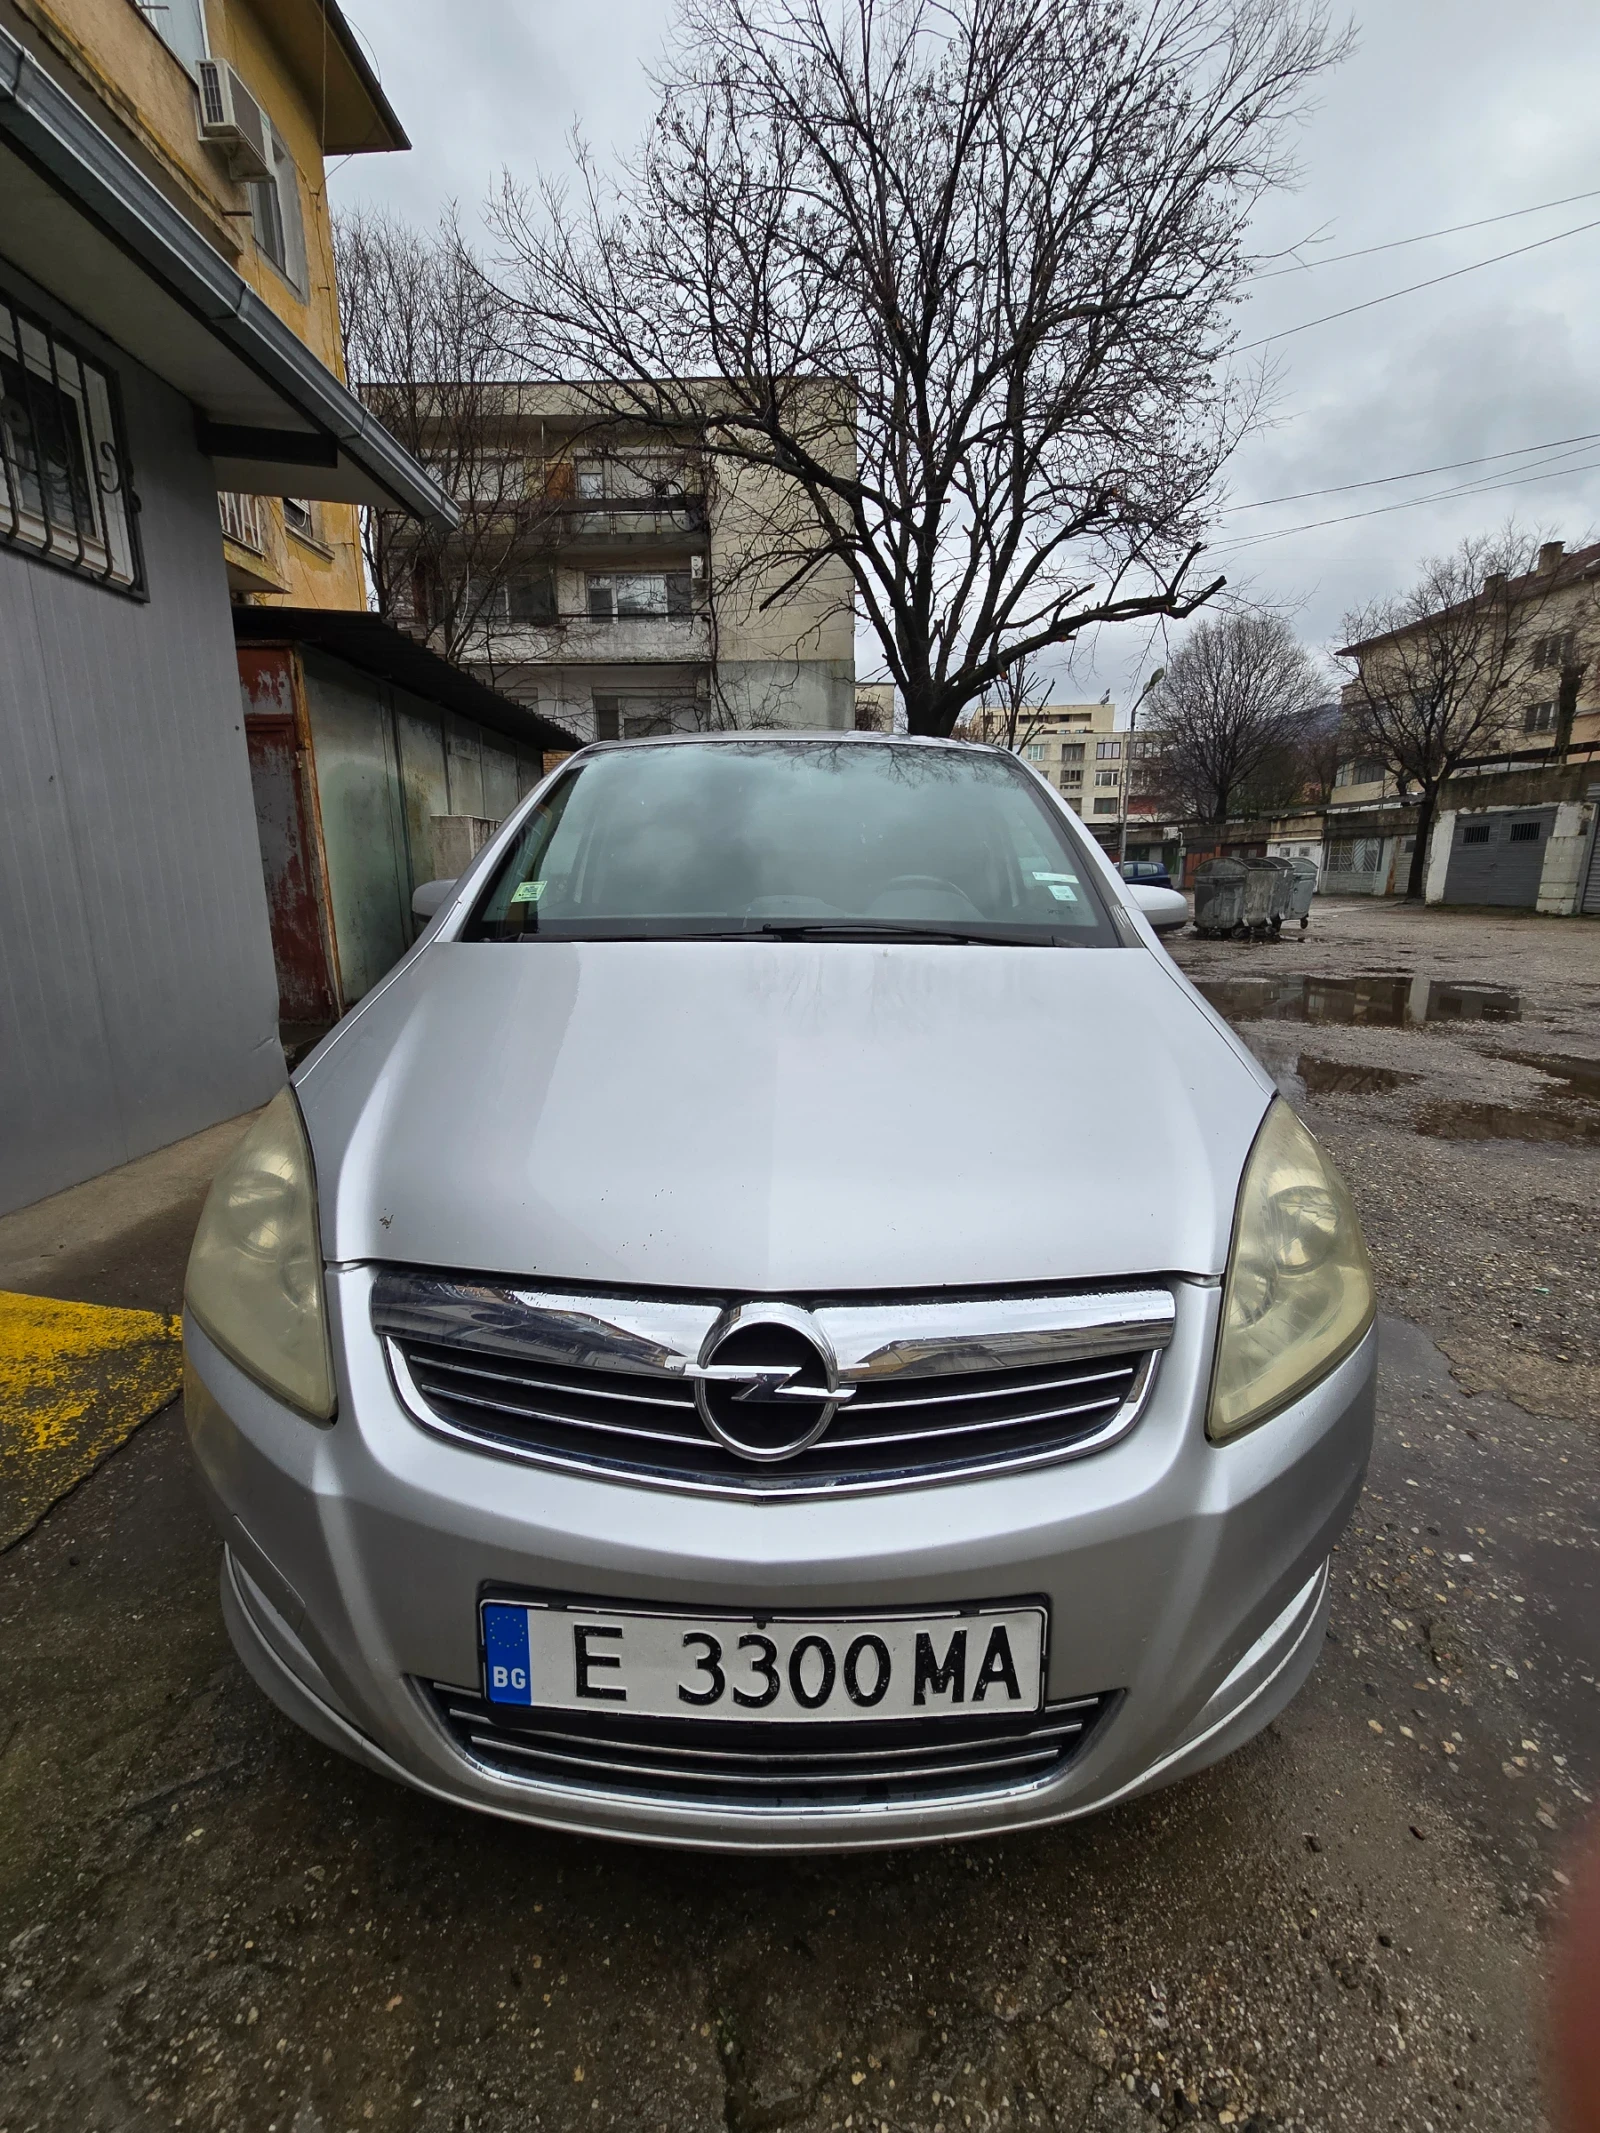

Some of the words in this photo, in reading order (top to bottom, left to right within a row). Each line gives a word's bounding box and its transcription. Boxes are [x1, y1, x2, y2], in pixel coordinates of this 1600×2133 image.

[493, 1665, 526, 1690] BG
[573, 1624, 627, 1701] E
[678, 1631, 891, 1709] 3300
[913, 1625, 1021, 1705] MA
